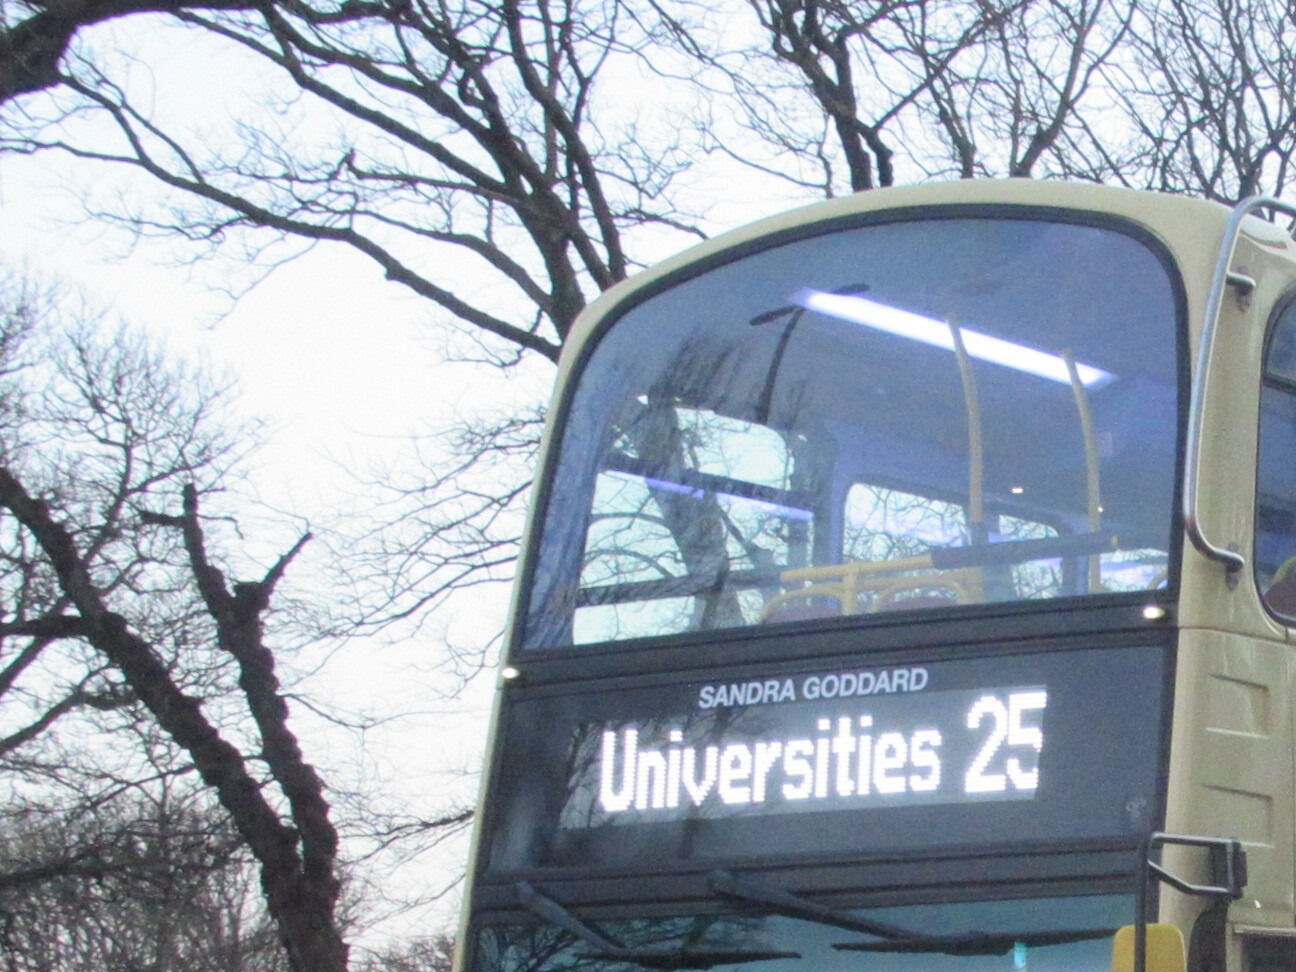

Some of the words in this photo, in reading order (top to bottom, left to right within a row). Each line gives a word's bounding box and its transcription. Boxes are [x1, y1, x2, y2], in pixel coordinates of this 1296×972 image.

[699, 680, 796, 709] SANDRA
[803, 668, 928, 699] GODDARD
[600, 715, 942, 812] Universities
[964, 691, 1047, 794] 25
